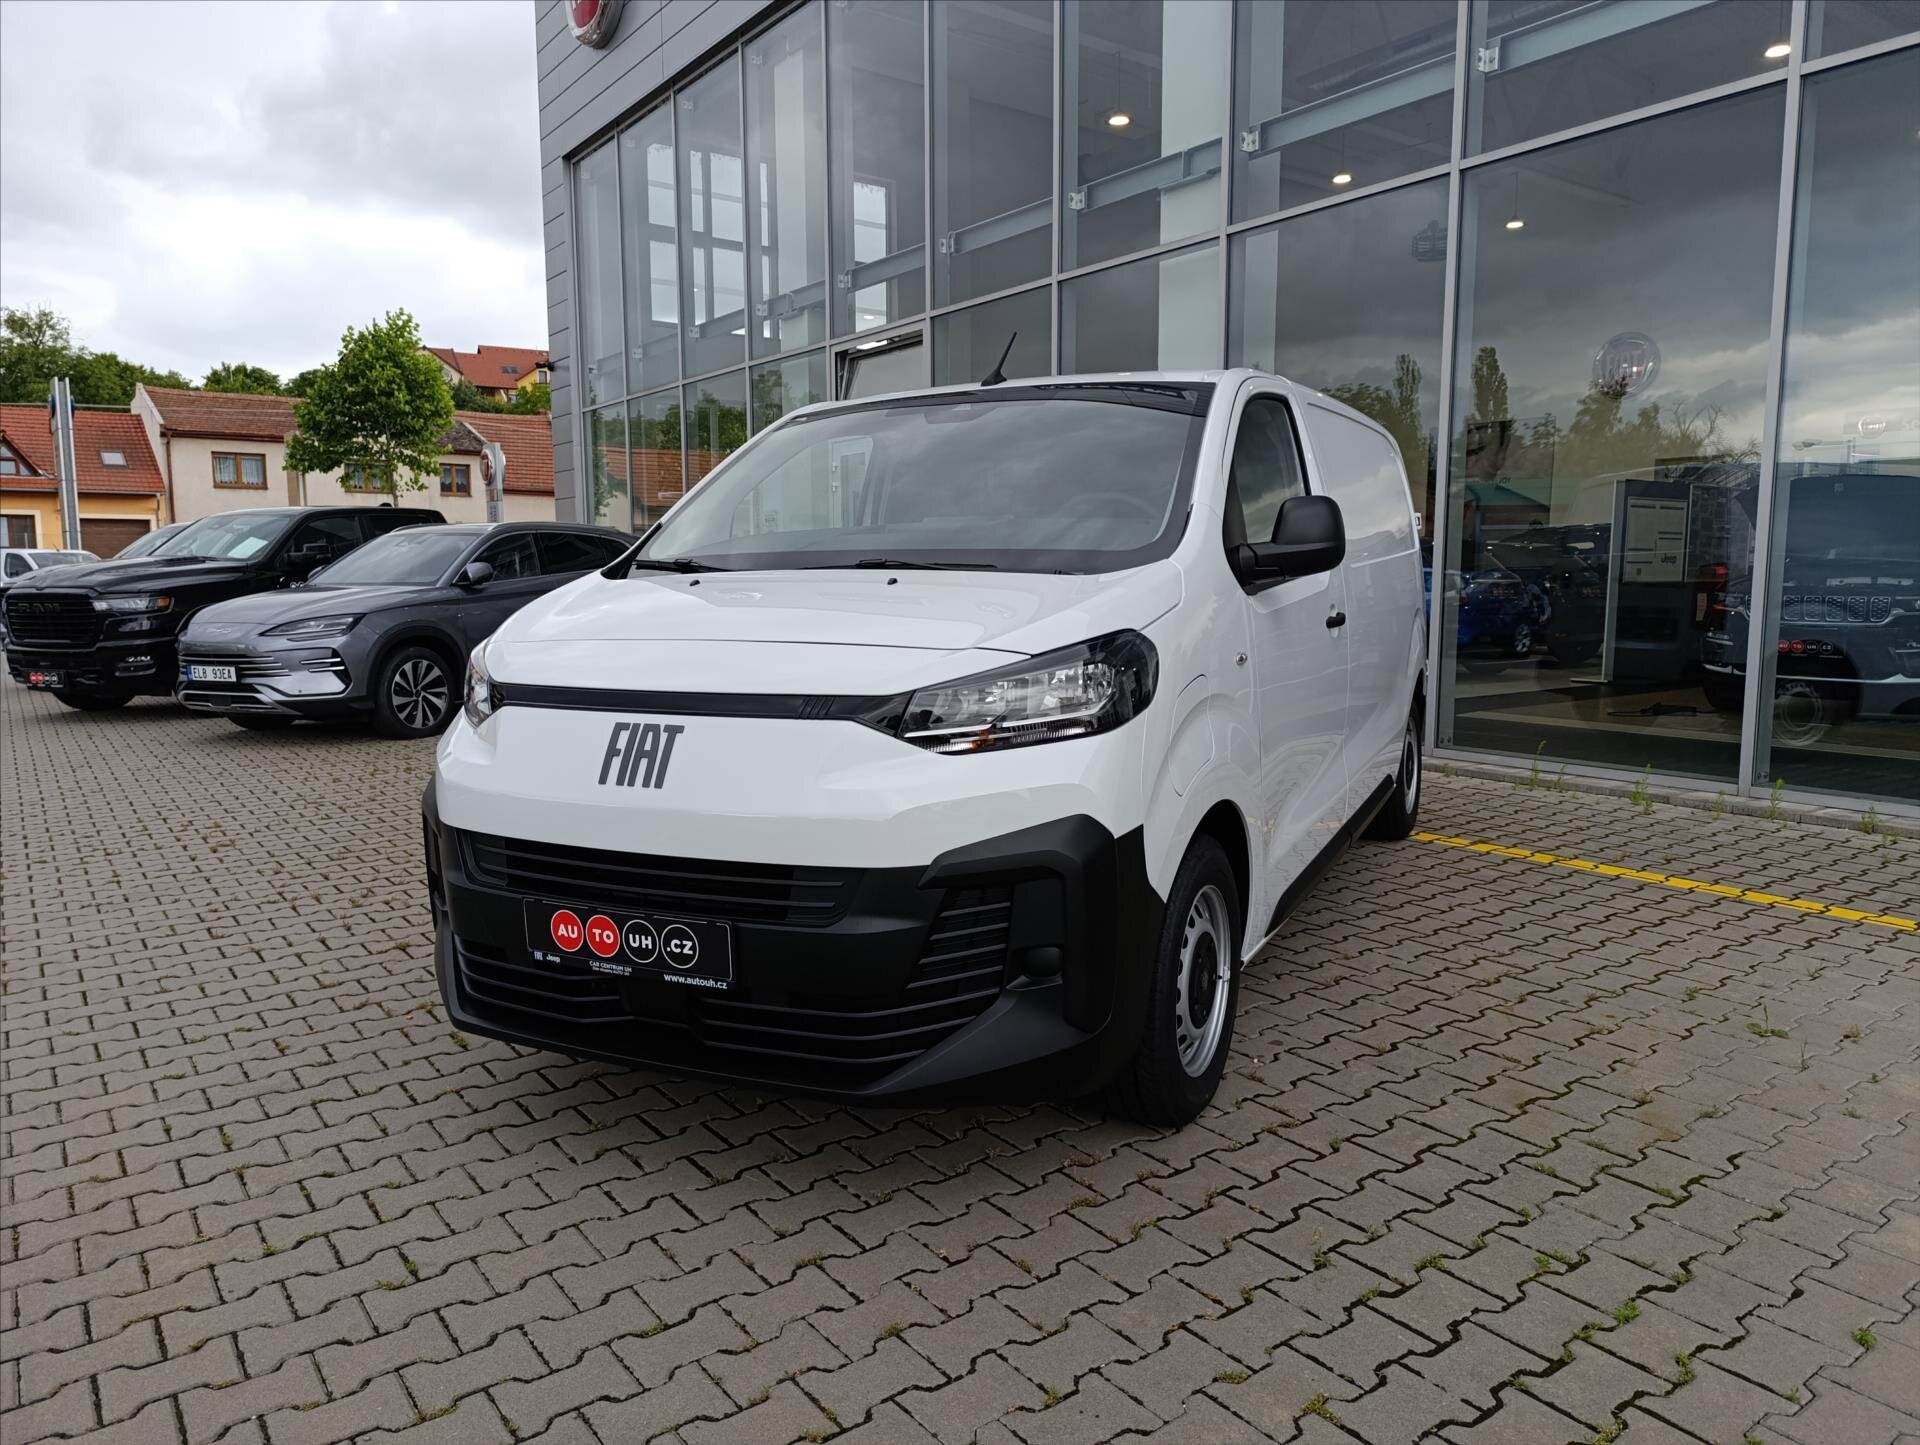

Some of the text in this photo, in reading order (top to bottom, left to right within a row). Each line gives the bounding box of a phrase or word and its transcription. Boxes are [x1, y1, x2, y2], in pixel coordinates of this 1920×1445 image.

[598, 722, 685, 789] FIAT
[557, 924, 693, 954] AU TO UH .CZ
[600, 962, 623, 971] CENTRUM
[663, 973, 728, 990] www.autouh.cz
